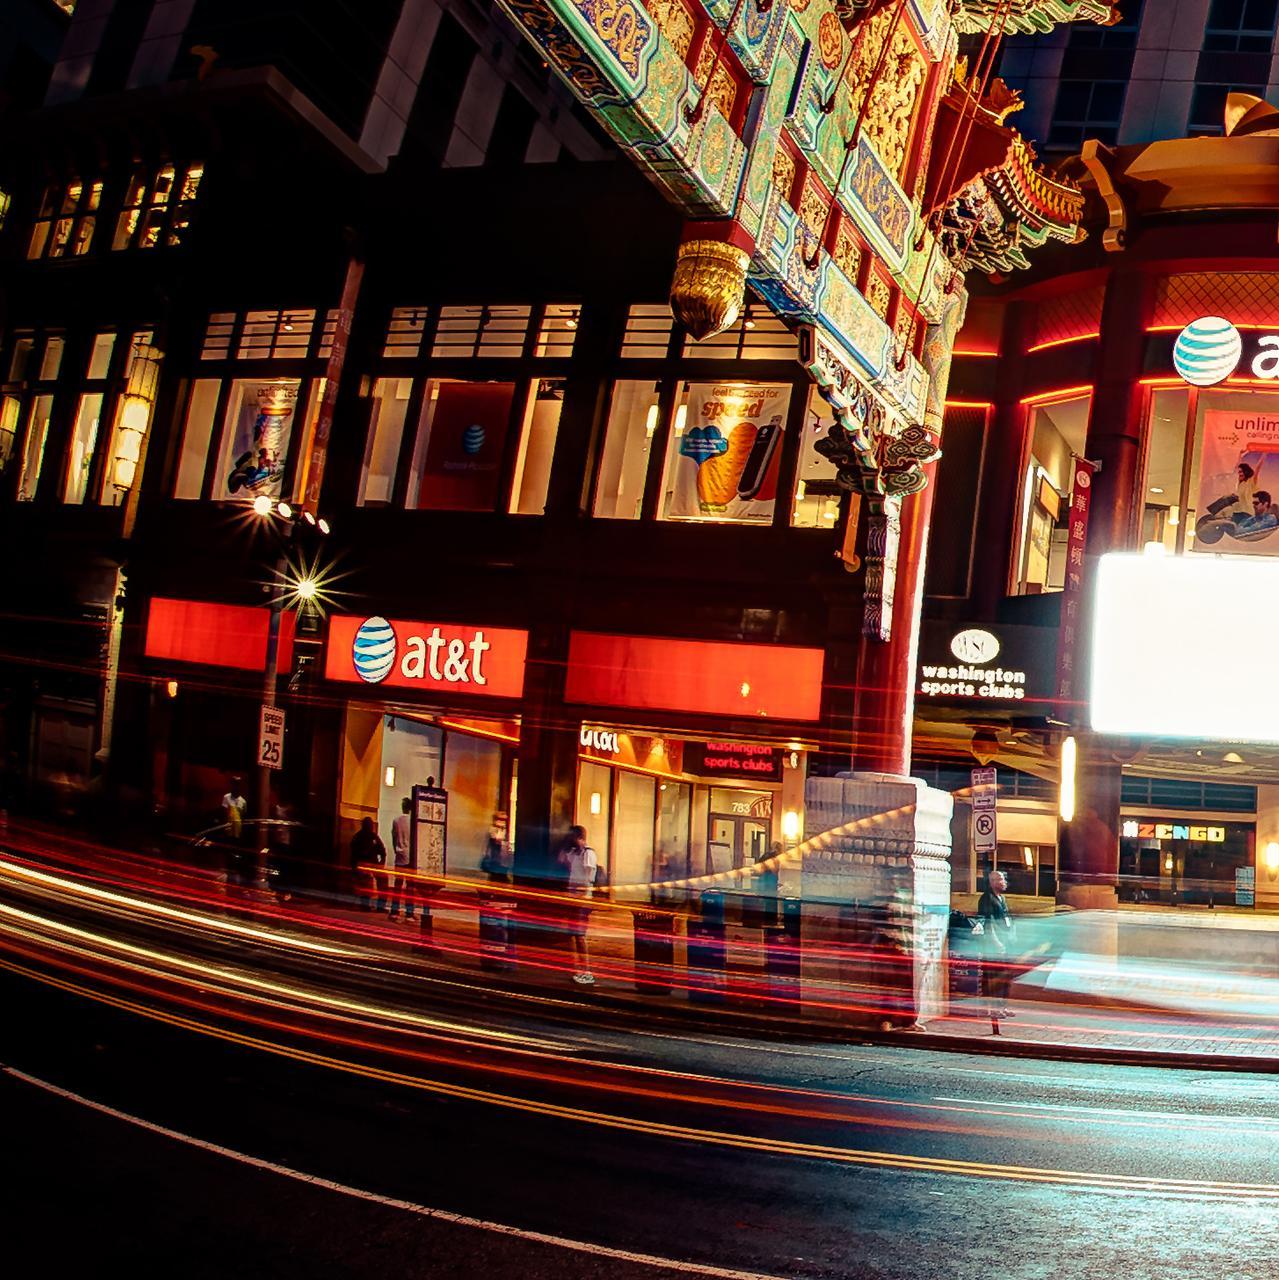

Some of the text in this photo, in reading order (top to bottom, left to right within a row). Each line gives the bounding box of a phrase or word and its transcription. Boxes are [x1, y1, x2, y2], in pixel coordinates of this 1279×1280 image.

[1246, 431, 1272, 441] calling
[401, 627, 491, 685] at&t
[922, 664, 1026, 684] washington
[920, 680, 1025, 699] sports clubs
[264, 712, 283, 725] SPEED
[264, 722, 281, 735] LIMIT
[262, 739, 280, 763] 25
[706, 741, 773, 756] washington
[703, 756, 774, 772] sports clubs
[732, 802, 751, 813] 783
[1138, 823, 1225, 842] ZENGO
